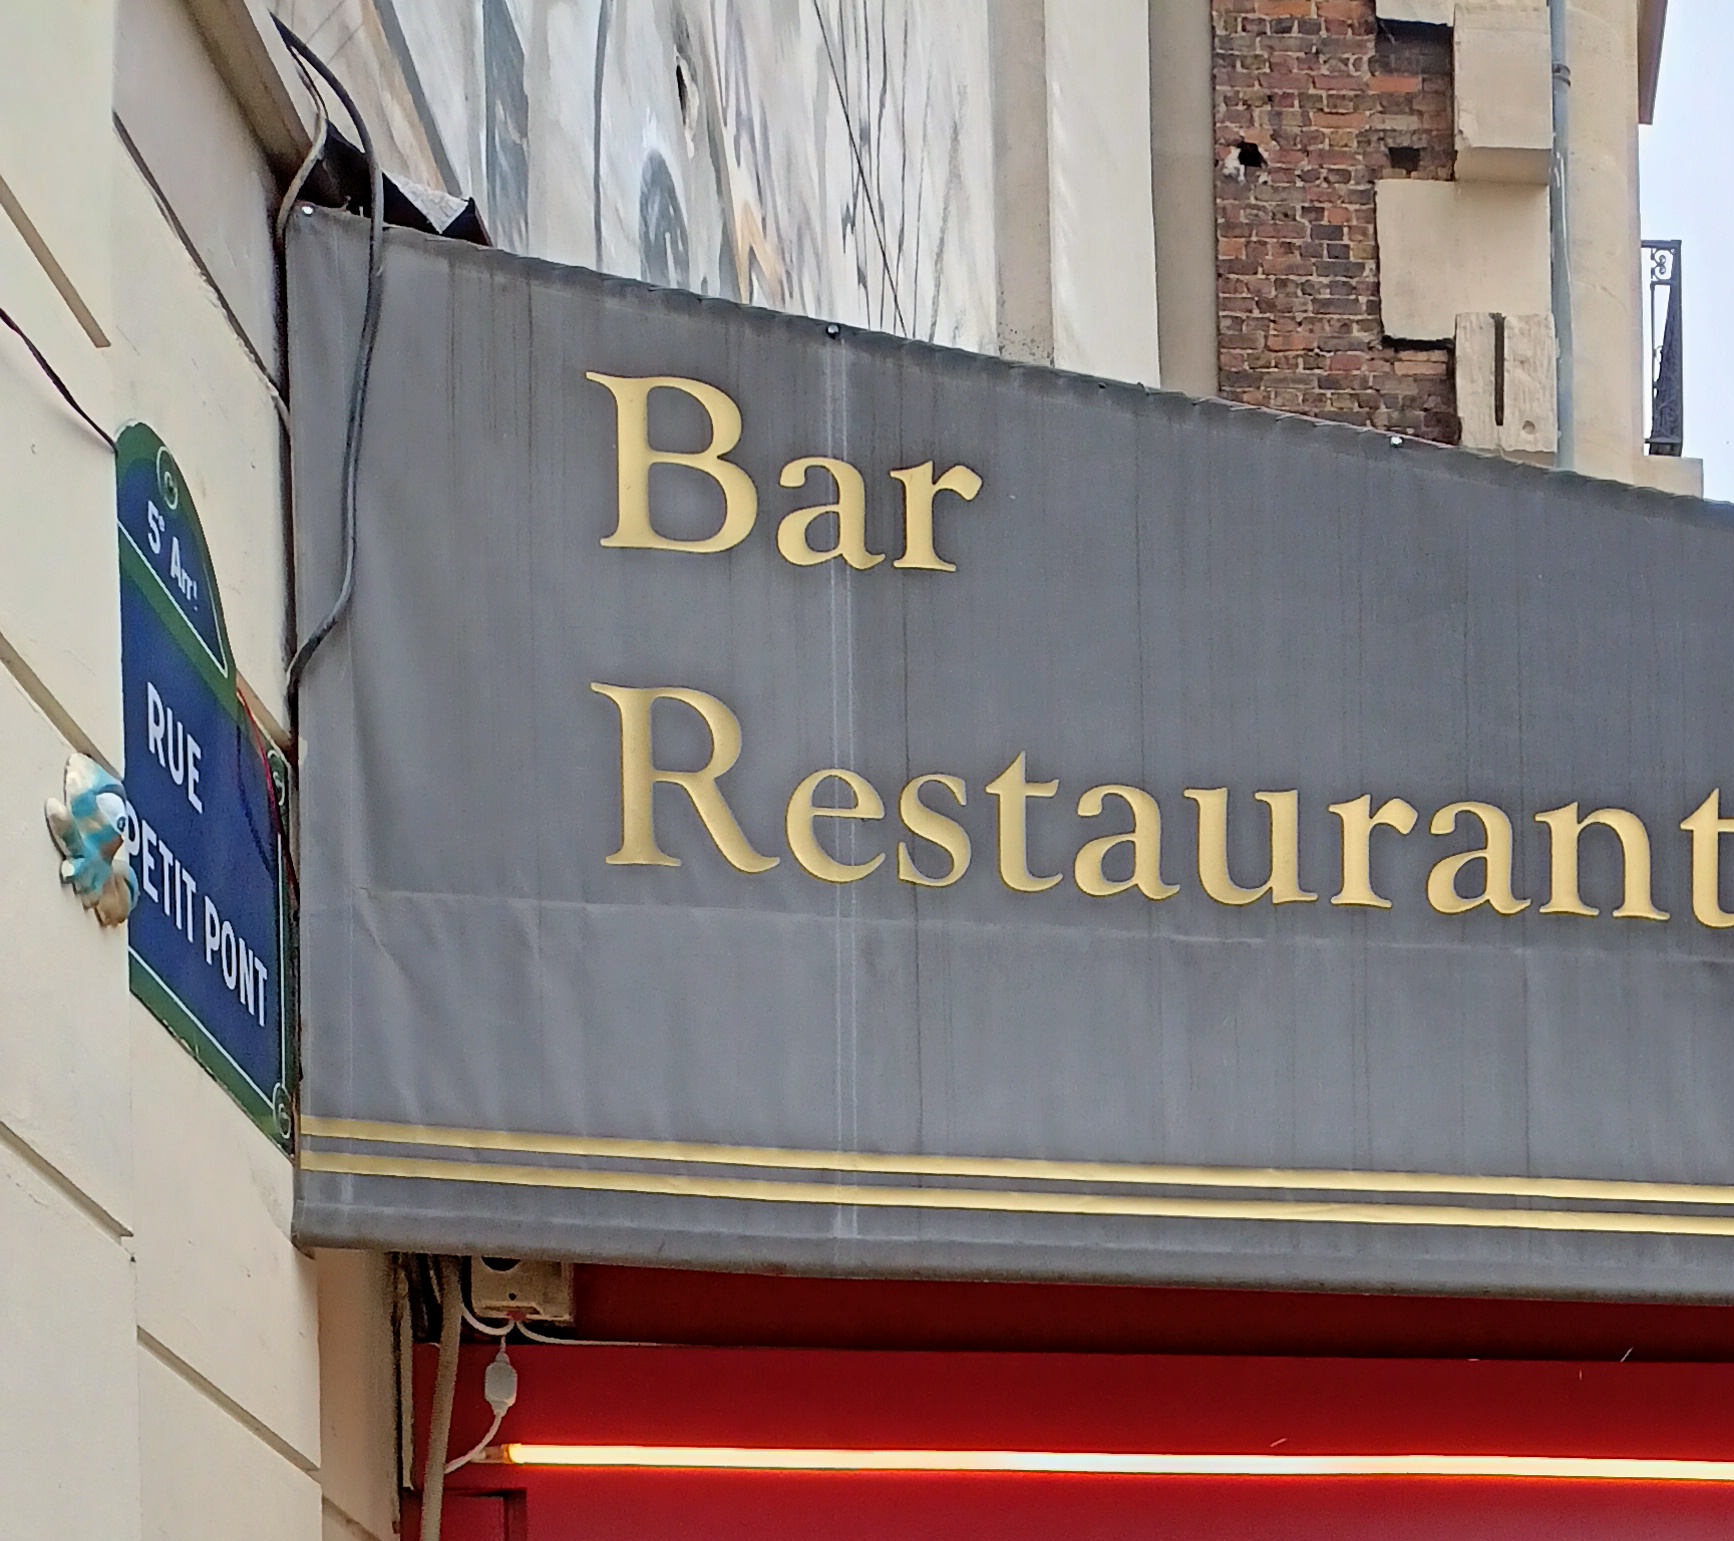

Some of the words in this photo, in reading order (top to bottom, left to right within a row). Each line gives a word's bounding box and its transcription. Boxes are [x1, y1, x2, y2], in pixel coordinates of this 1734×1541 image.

[585, 371, 983, 573] Bar
[147, 682, 203, 814] RUE
[126, 801, 196, 943] PETIT
[204, 895, 268, 1027] PONT
